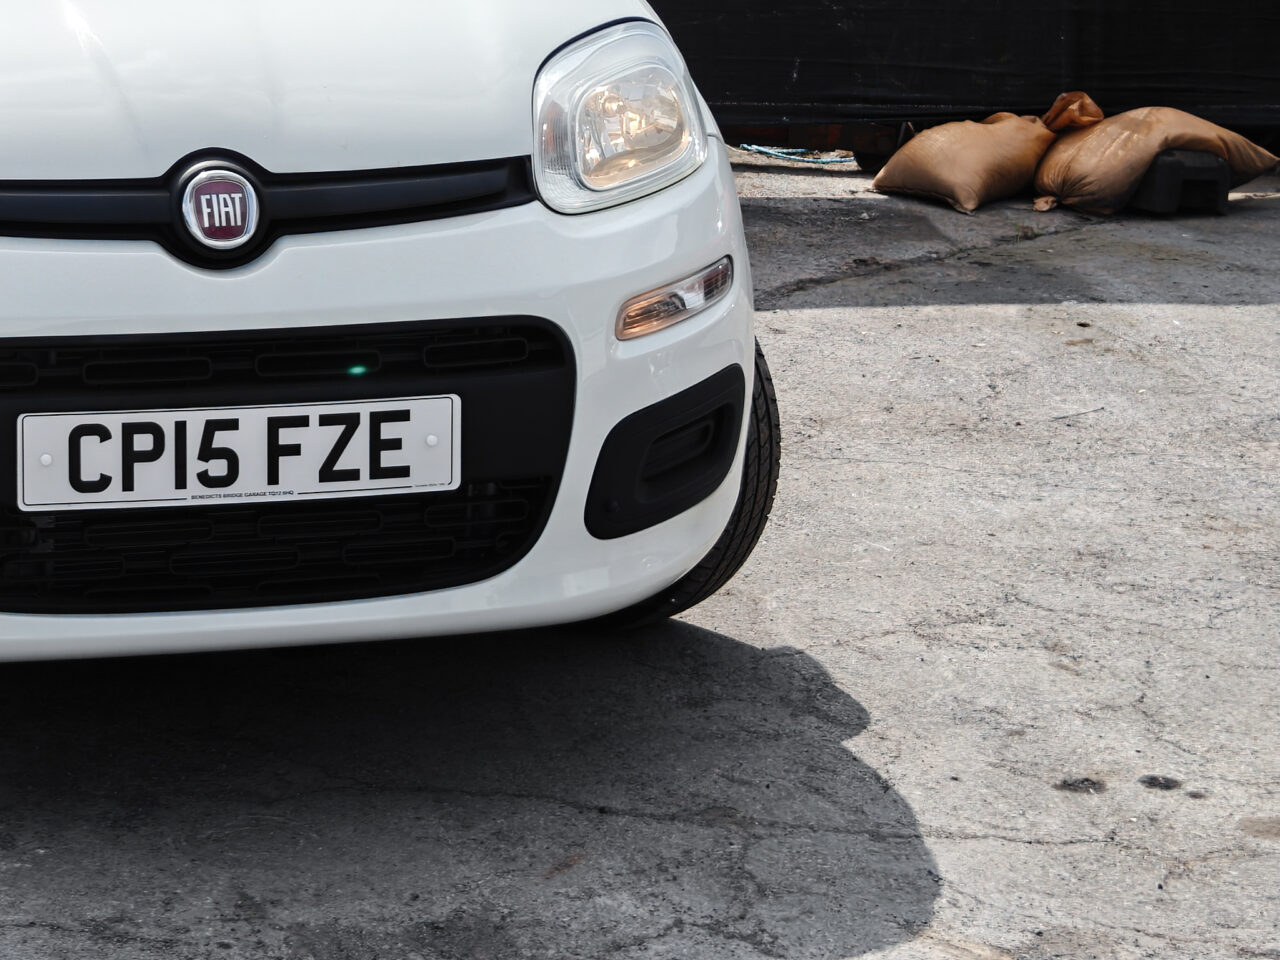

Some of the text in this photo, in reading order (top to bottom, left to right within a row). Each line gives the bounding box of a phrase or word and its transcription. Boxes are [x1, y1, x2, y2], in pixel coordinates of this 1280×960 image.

[200, 193, 242, 228] FIAT
[68, 409, 410, 493] CP15 FZE
